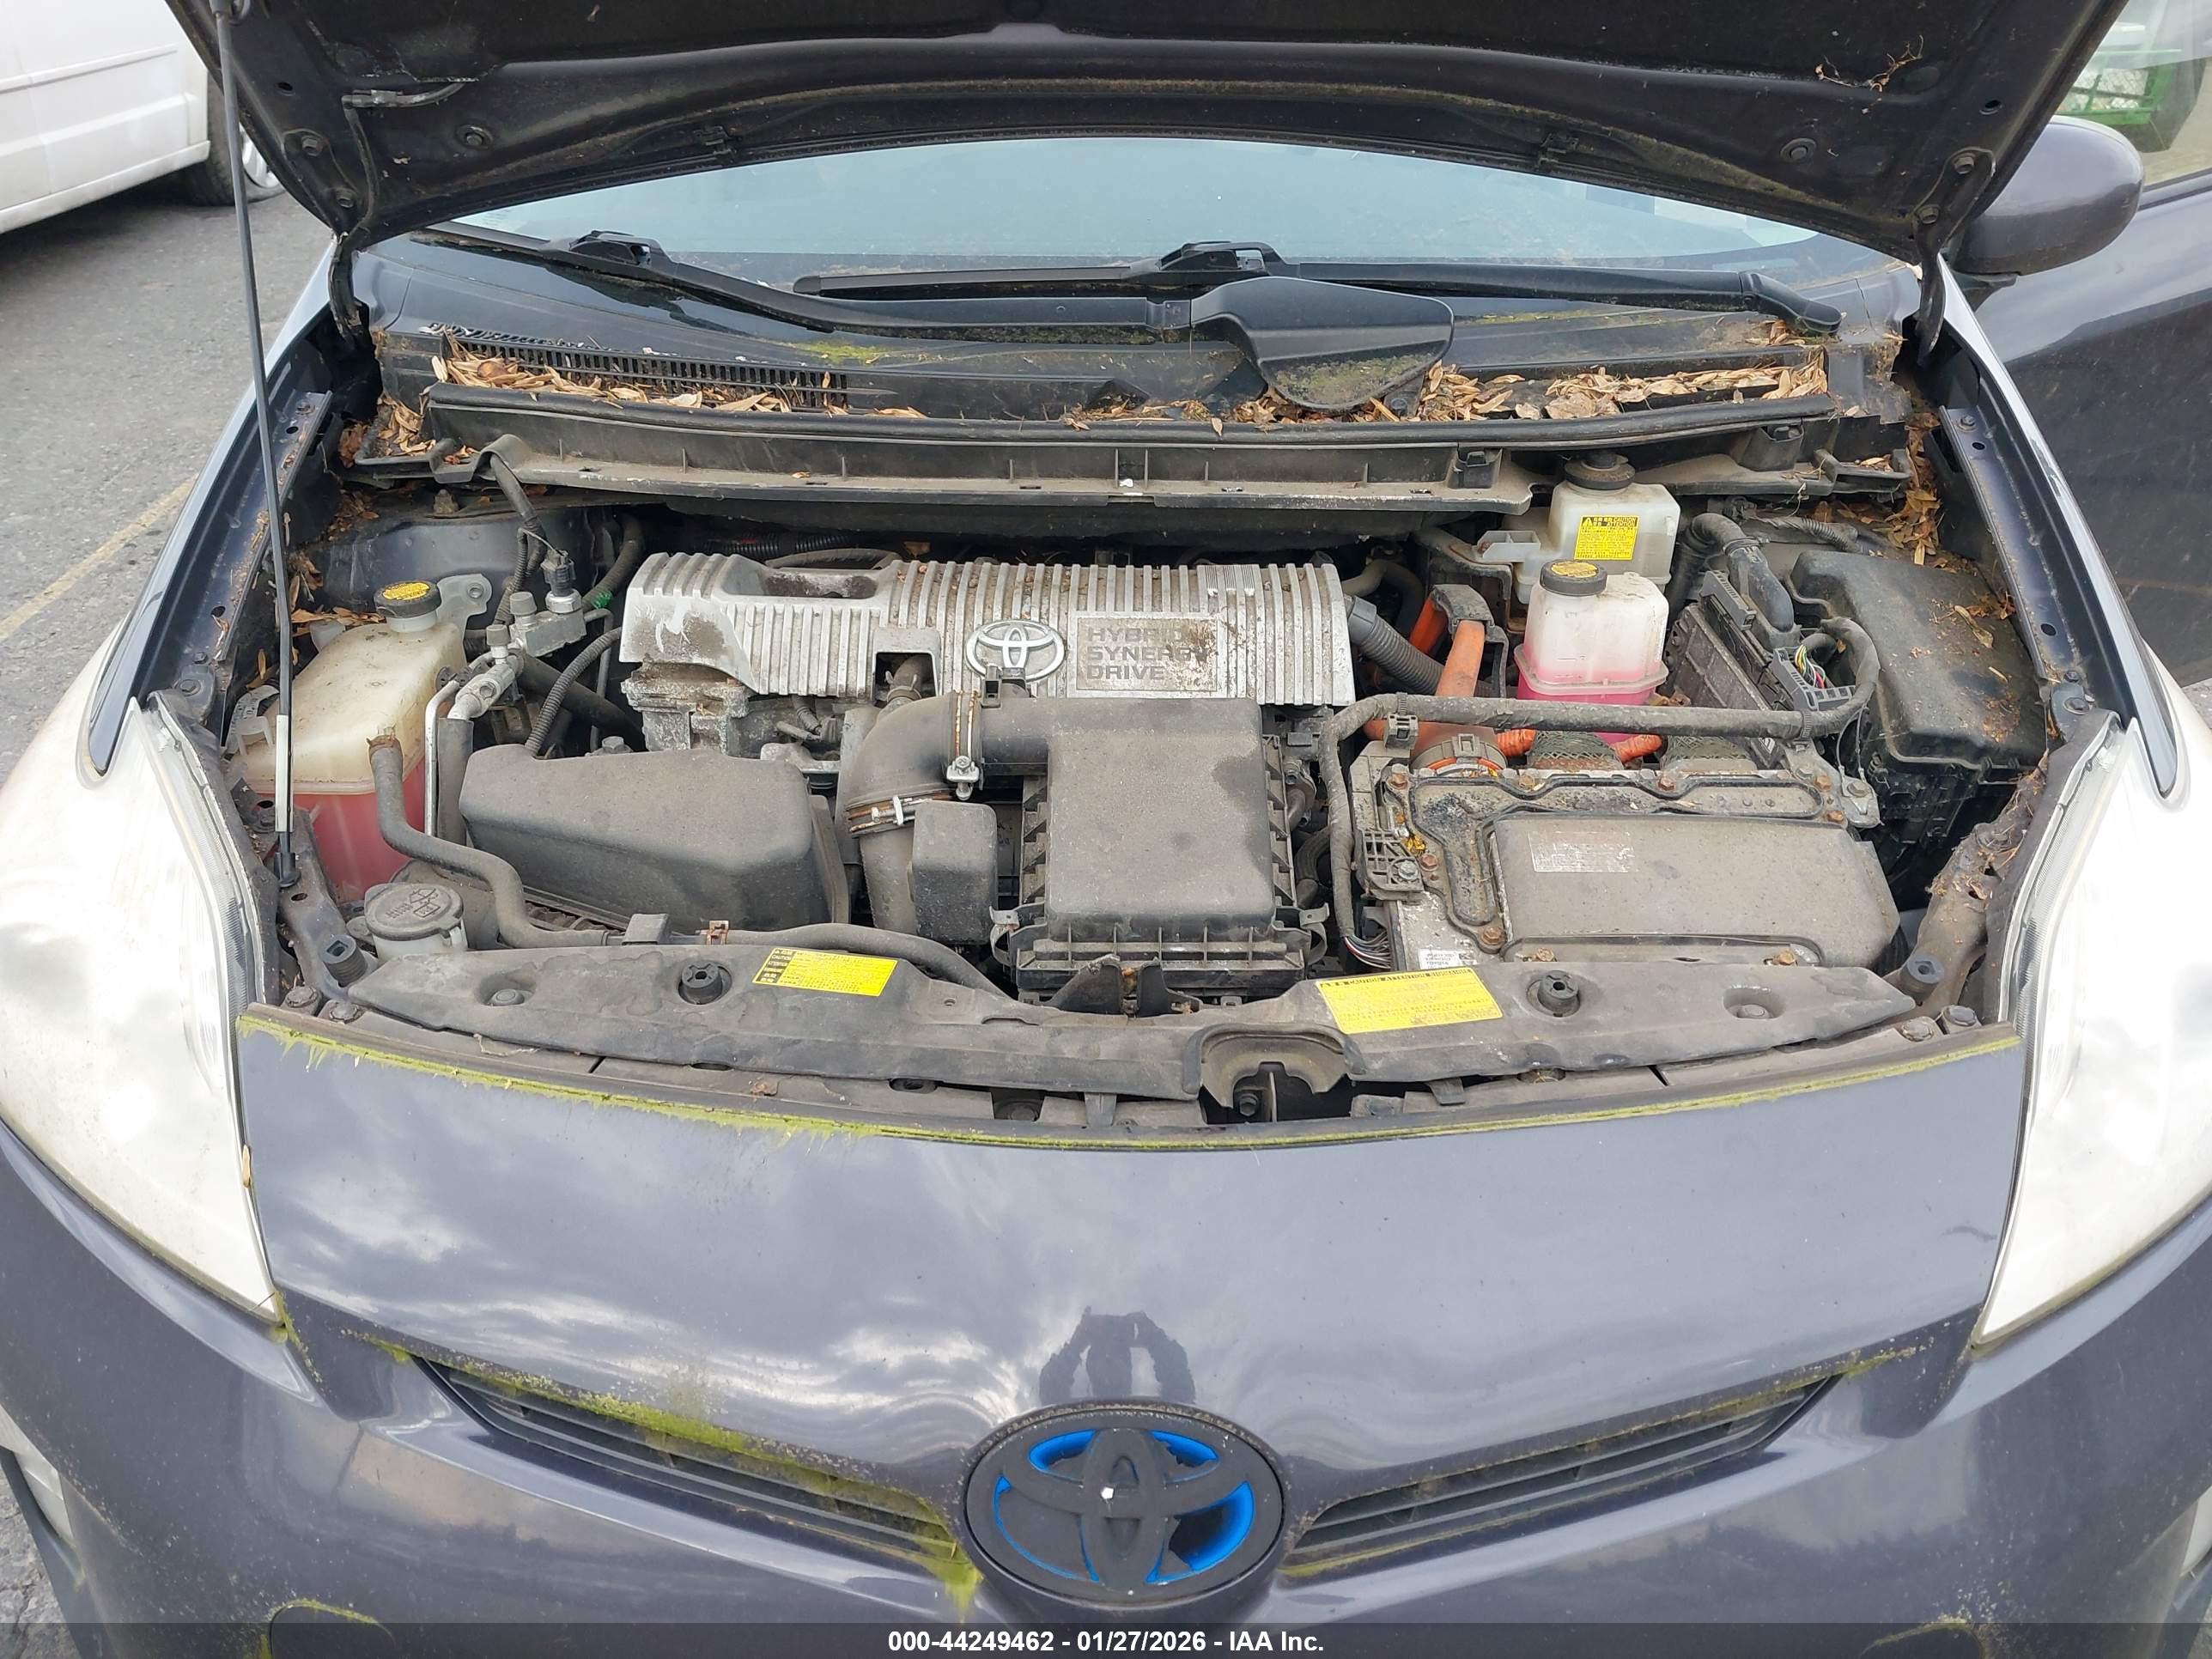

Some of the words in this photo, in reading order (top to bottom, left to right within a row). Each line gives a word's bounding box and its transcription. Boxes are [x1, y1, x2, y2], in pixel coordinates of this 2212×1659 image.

[1087, 628, 1189, 642] HYBRID
[1087, 647, 1207, 662] SYNERGY
[1087, 665, 1165, 680] DRIVE
